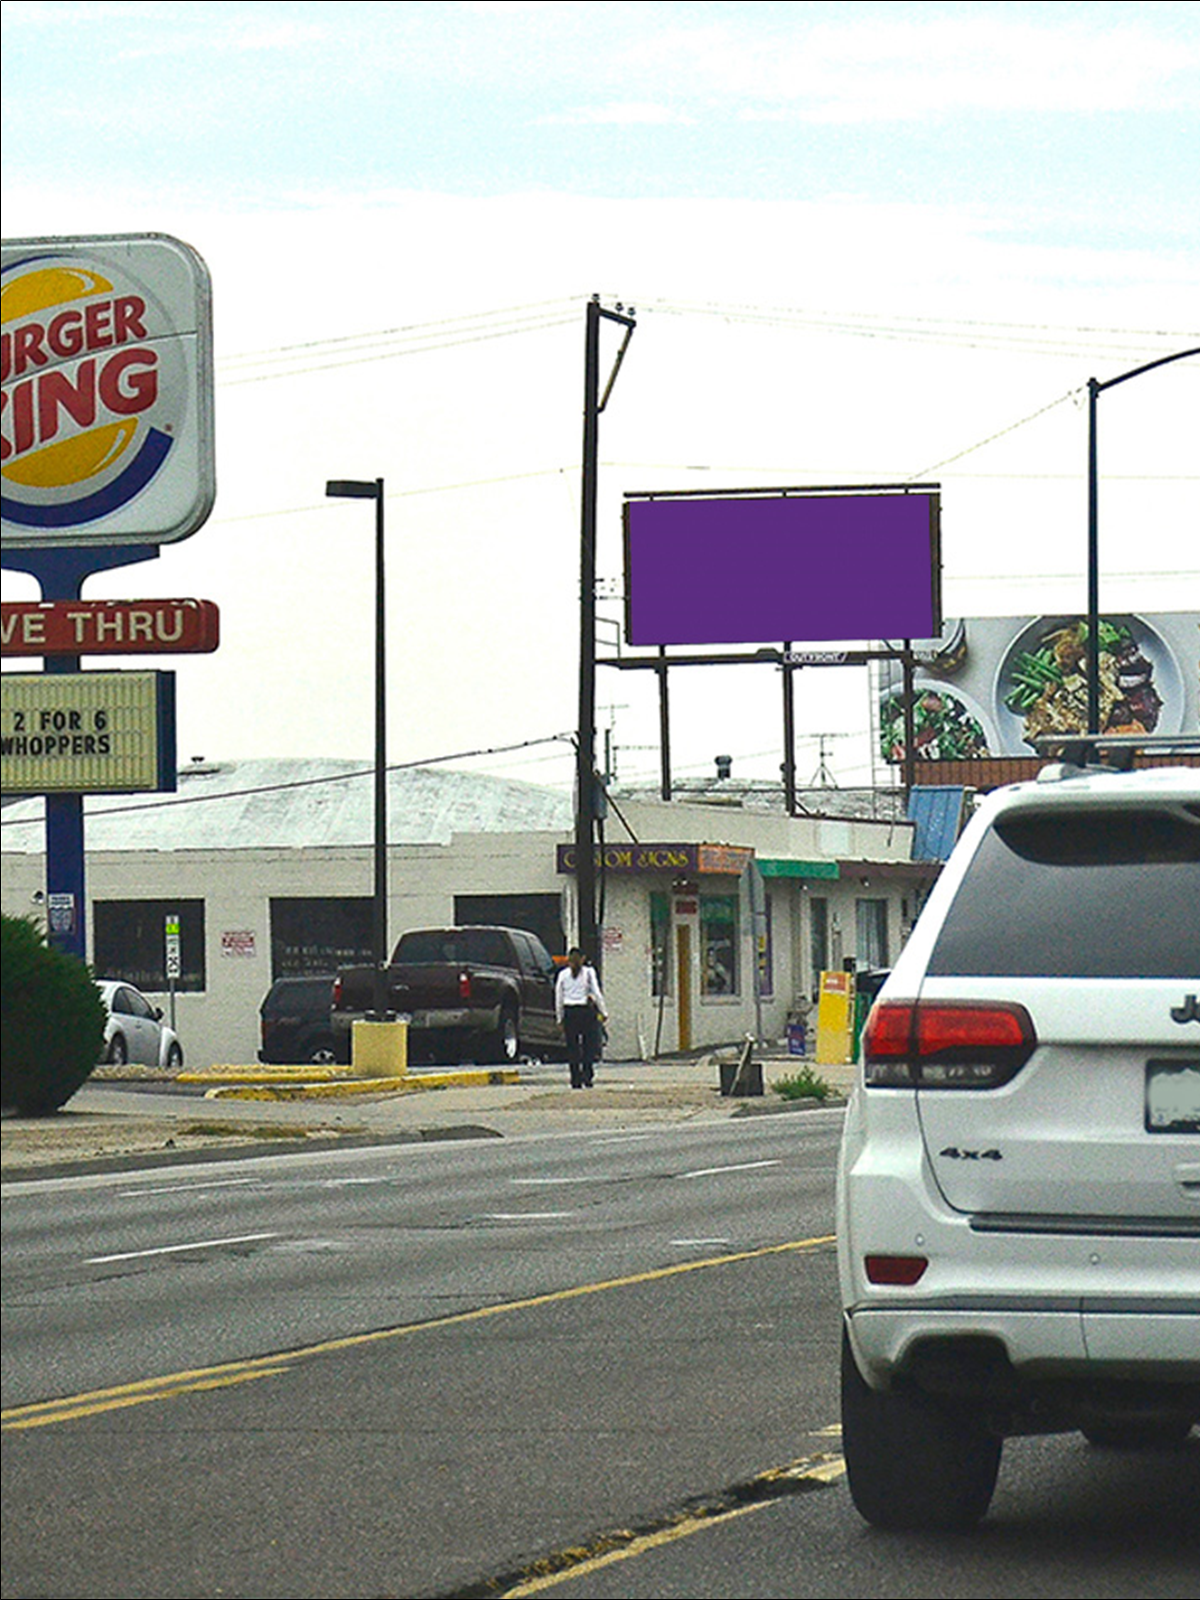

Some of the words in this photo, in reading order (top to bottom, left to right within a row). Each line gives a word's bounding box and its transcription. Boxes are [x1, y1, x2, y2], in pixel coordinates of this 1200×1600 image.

[67, 609, 184, 643] THRU
[14, 711, 26, 731] 2
[40, 711, 83, 731] FOR
[94, 710, 108, 730] 6
[2, 734, 111, 755] WHOPPERS
[636, 850, 690, 868] SIGNS
[939, 1147, 1003, 1161] 4x4
